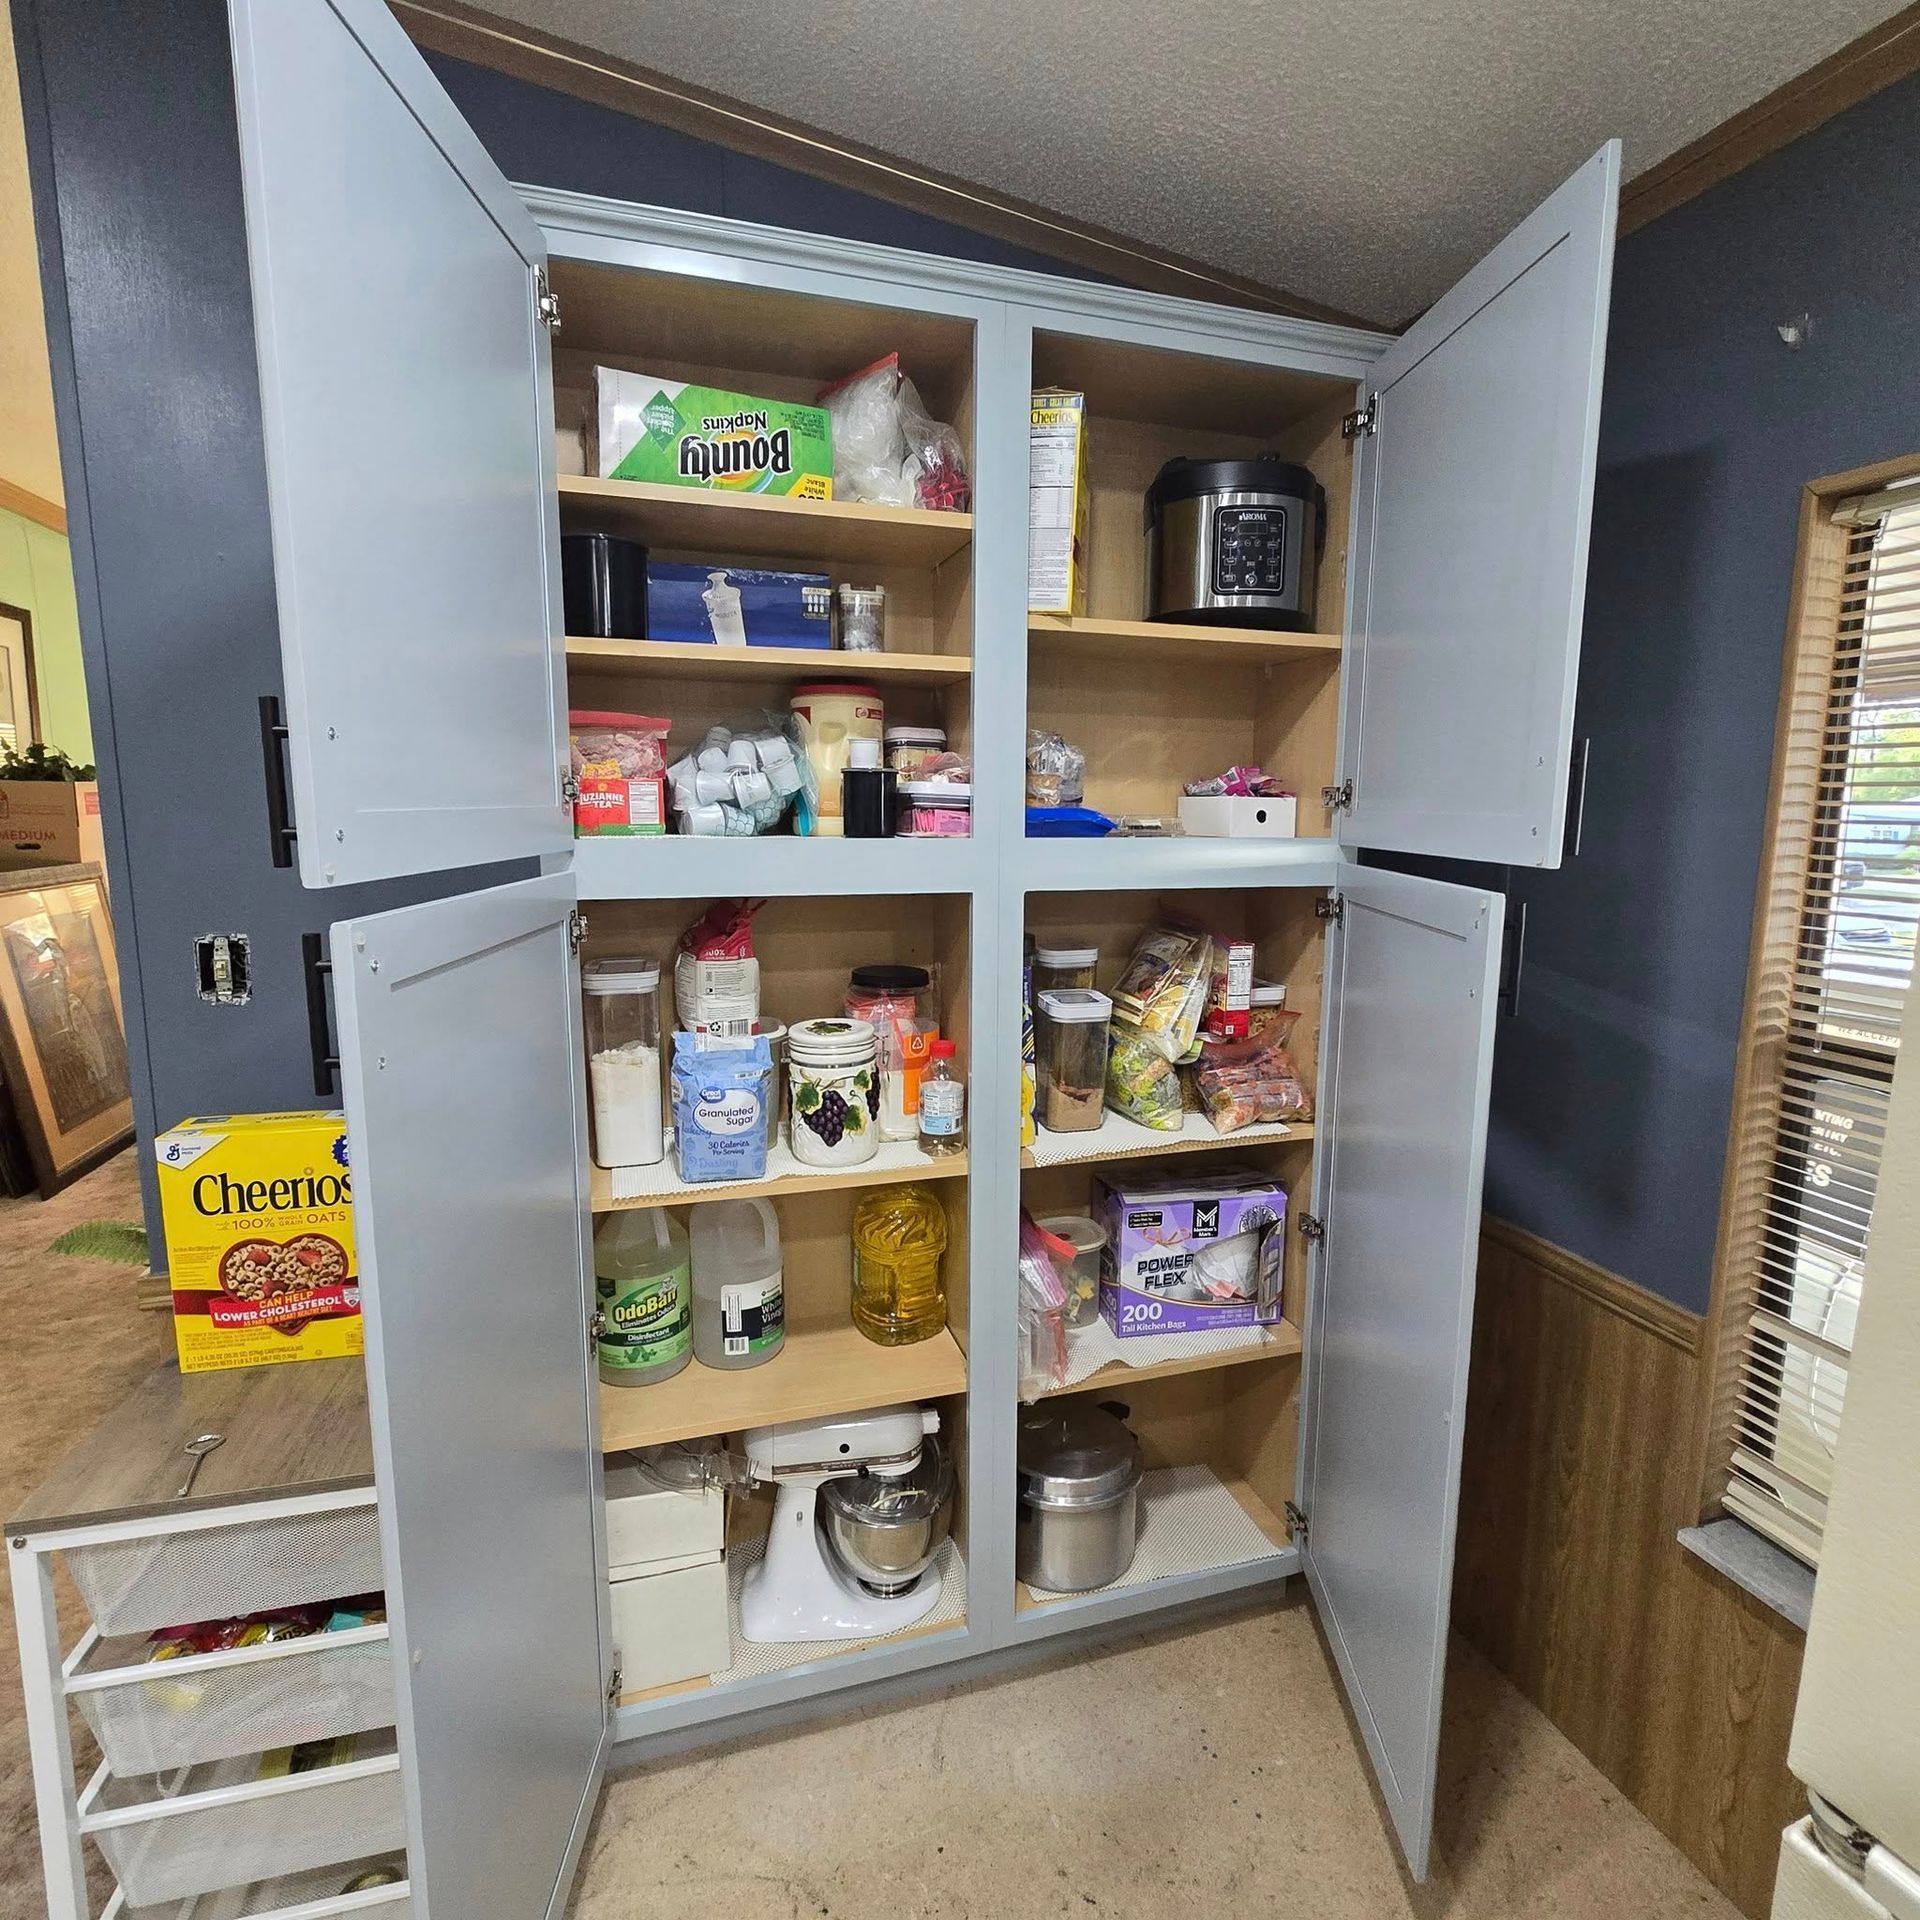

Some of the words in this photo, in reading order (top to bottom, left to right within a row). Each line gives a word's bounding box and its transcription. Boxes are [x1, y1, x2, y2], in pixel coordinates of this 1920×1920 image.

[702, 411, 768, 434] Napkins
[679, 429, 792, 482] Bounty
[806, 478, 826, 488] Blanc
[804, 486, 825, 496] White
[1239, 512, 1267, 521] AROMA
[594, 801, 613, 809] TEA
[698, 1105, 755, 1118] Granulated
[725, 1116, 755, 1127] Sugar
[708, 1141, 719, 1151] 30
[720, 1139, 750, 1149] Calories
[723, 1147, 745, 1157] Serving
[192, 1167, 353, 1217] Cheerios
[232, 1217, 275, 1231] 100%
[306, 1211, 346, 1225] OATS
[278, 1219, 304, 1227] GRAIN
[1137, 1253, 1195, 1276] POWER
[1144, 1270, 1188, 1291] FLEX
[259, 1295, 282, 1310] CAN
[284, 1290, 314, 1305] HELP
[614, 1288, 676, 1322] OdoBan
[213, 1309, 258, 1323] LOWER
[259, 1295, 342, 1318] CHOLESTEROL
[1122, 1302, 1163, 1323] 200
[621, 1315, 657, 1330] Eliminates
[1121, 1324, 1136, 1333] Tall
[1136, 1321, 1166, 1331] Kitchen
[1167, 1320, 1187, 1330] Bags
[627, 1327, 670, 1342] Disinfectant
